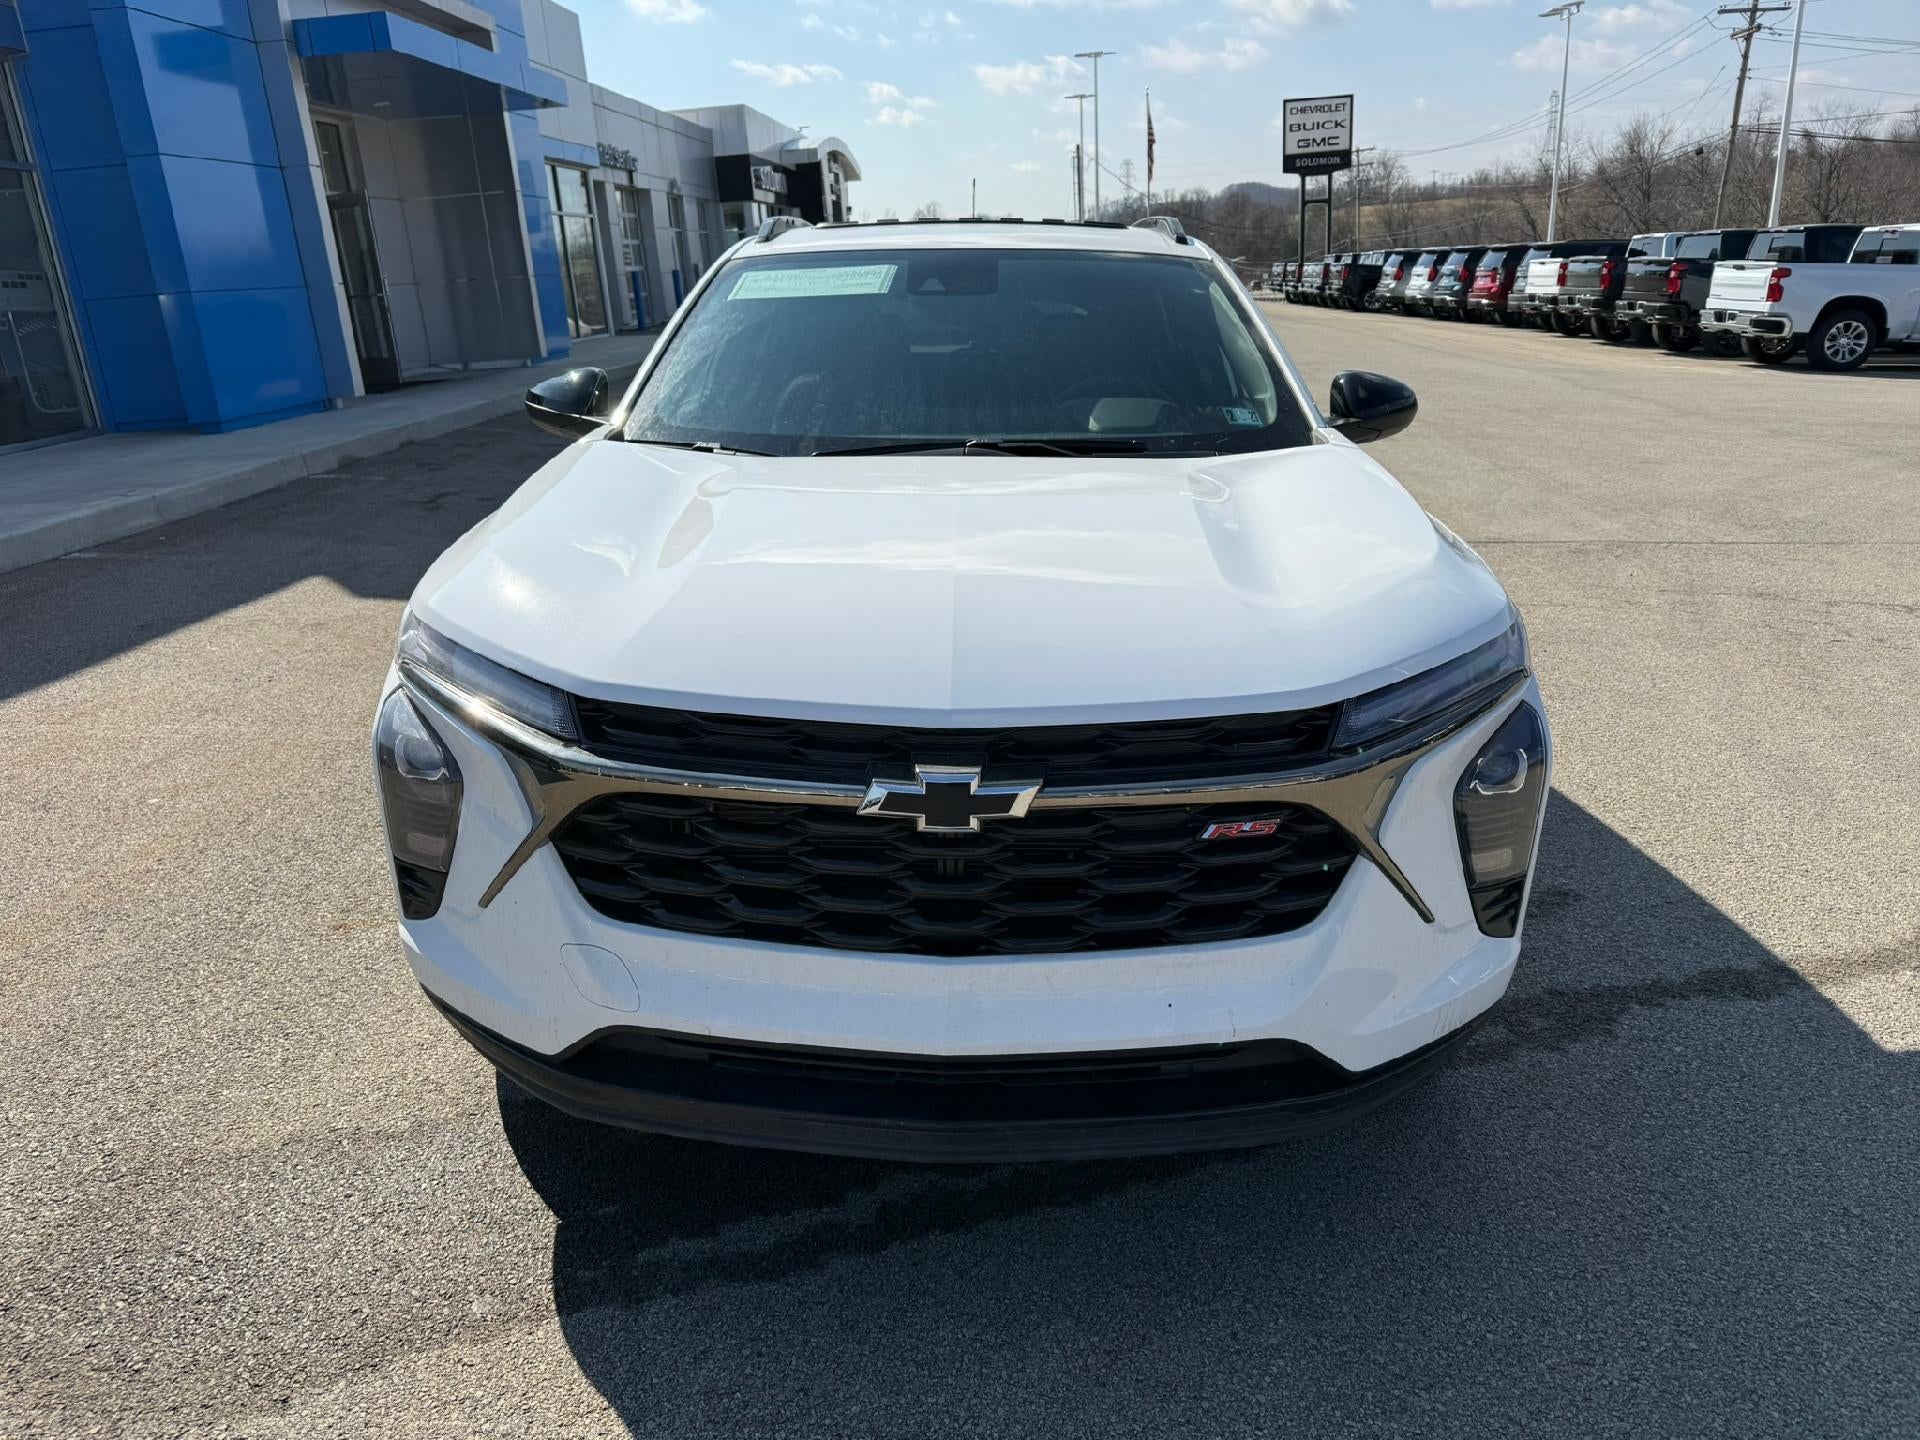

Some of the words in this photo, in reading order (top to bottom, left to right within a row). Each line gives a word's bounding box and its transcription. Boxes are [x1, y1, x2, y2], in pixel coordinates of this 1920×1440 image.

[1289, 102, 1347, 115] CHEVROLET
[1289, 119, 1347, 132] BUICK
[1297, 136, 1340, 148] GMC
[1295, 156, 1341, 167] SOLOMON
[1201, 819, 1280, 839] RS
